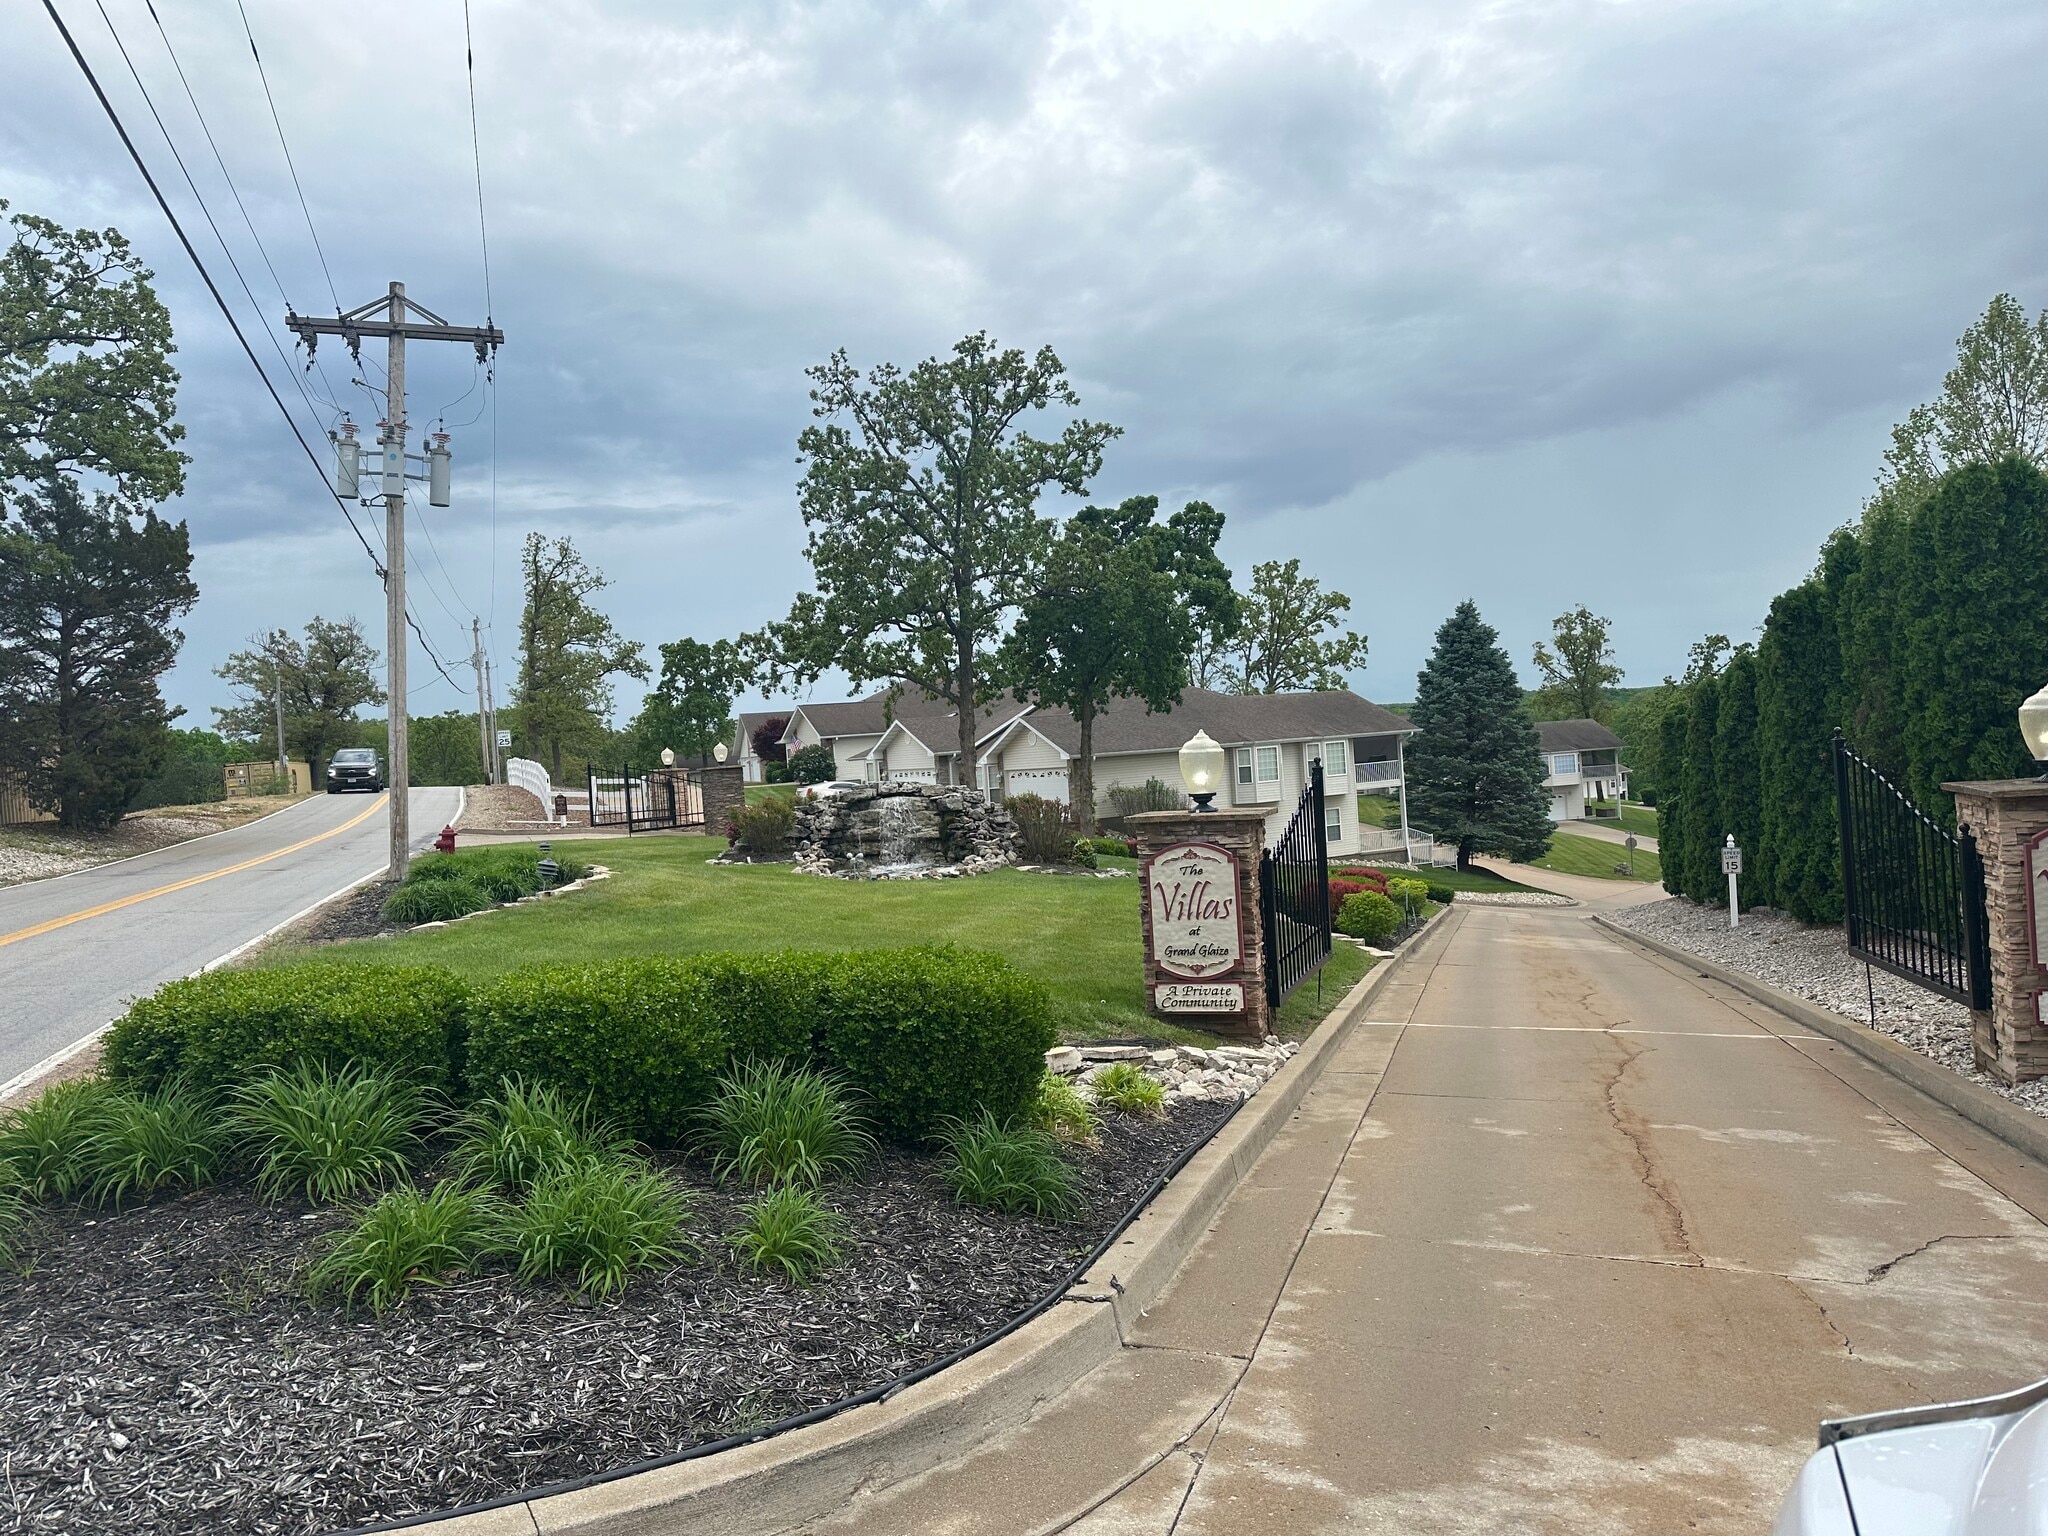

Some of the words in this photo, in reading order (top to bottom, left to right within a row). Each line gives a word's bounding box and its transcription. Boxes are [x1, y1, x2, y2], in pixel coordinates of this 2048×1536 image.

[499, 738, 510, 746] 25
[1179, 863, 1204, 876] The
[1725, 861, 1739, 870] 15
[1154, 880, 1233, 922] Villas
[1188, 925, 1202, 936] at
[1164, 942, 1199, 958] Grand
[1199, 942, 1230, 958] Glaize
[1166, 986, 1179, 996] A
[1182, 985, 1232, 996] Private
[1161, 996, 1238, 1011] Community
